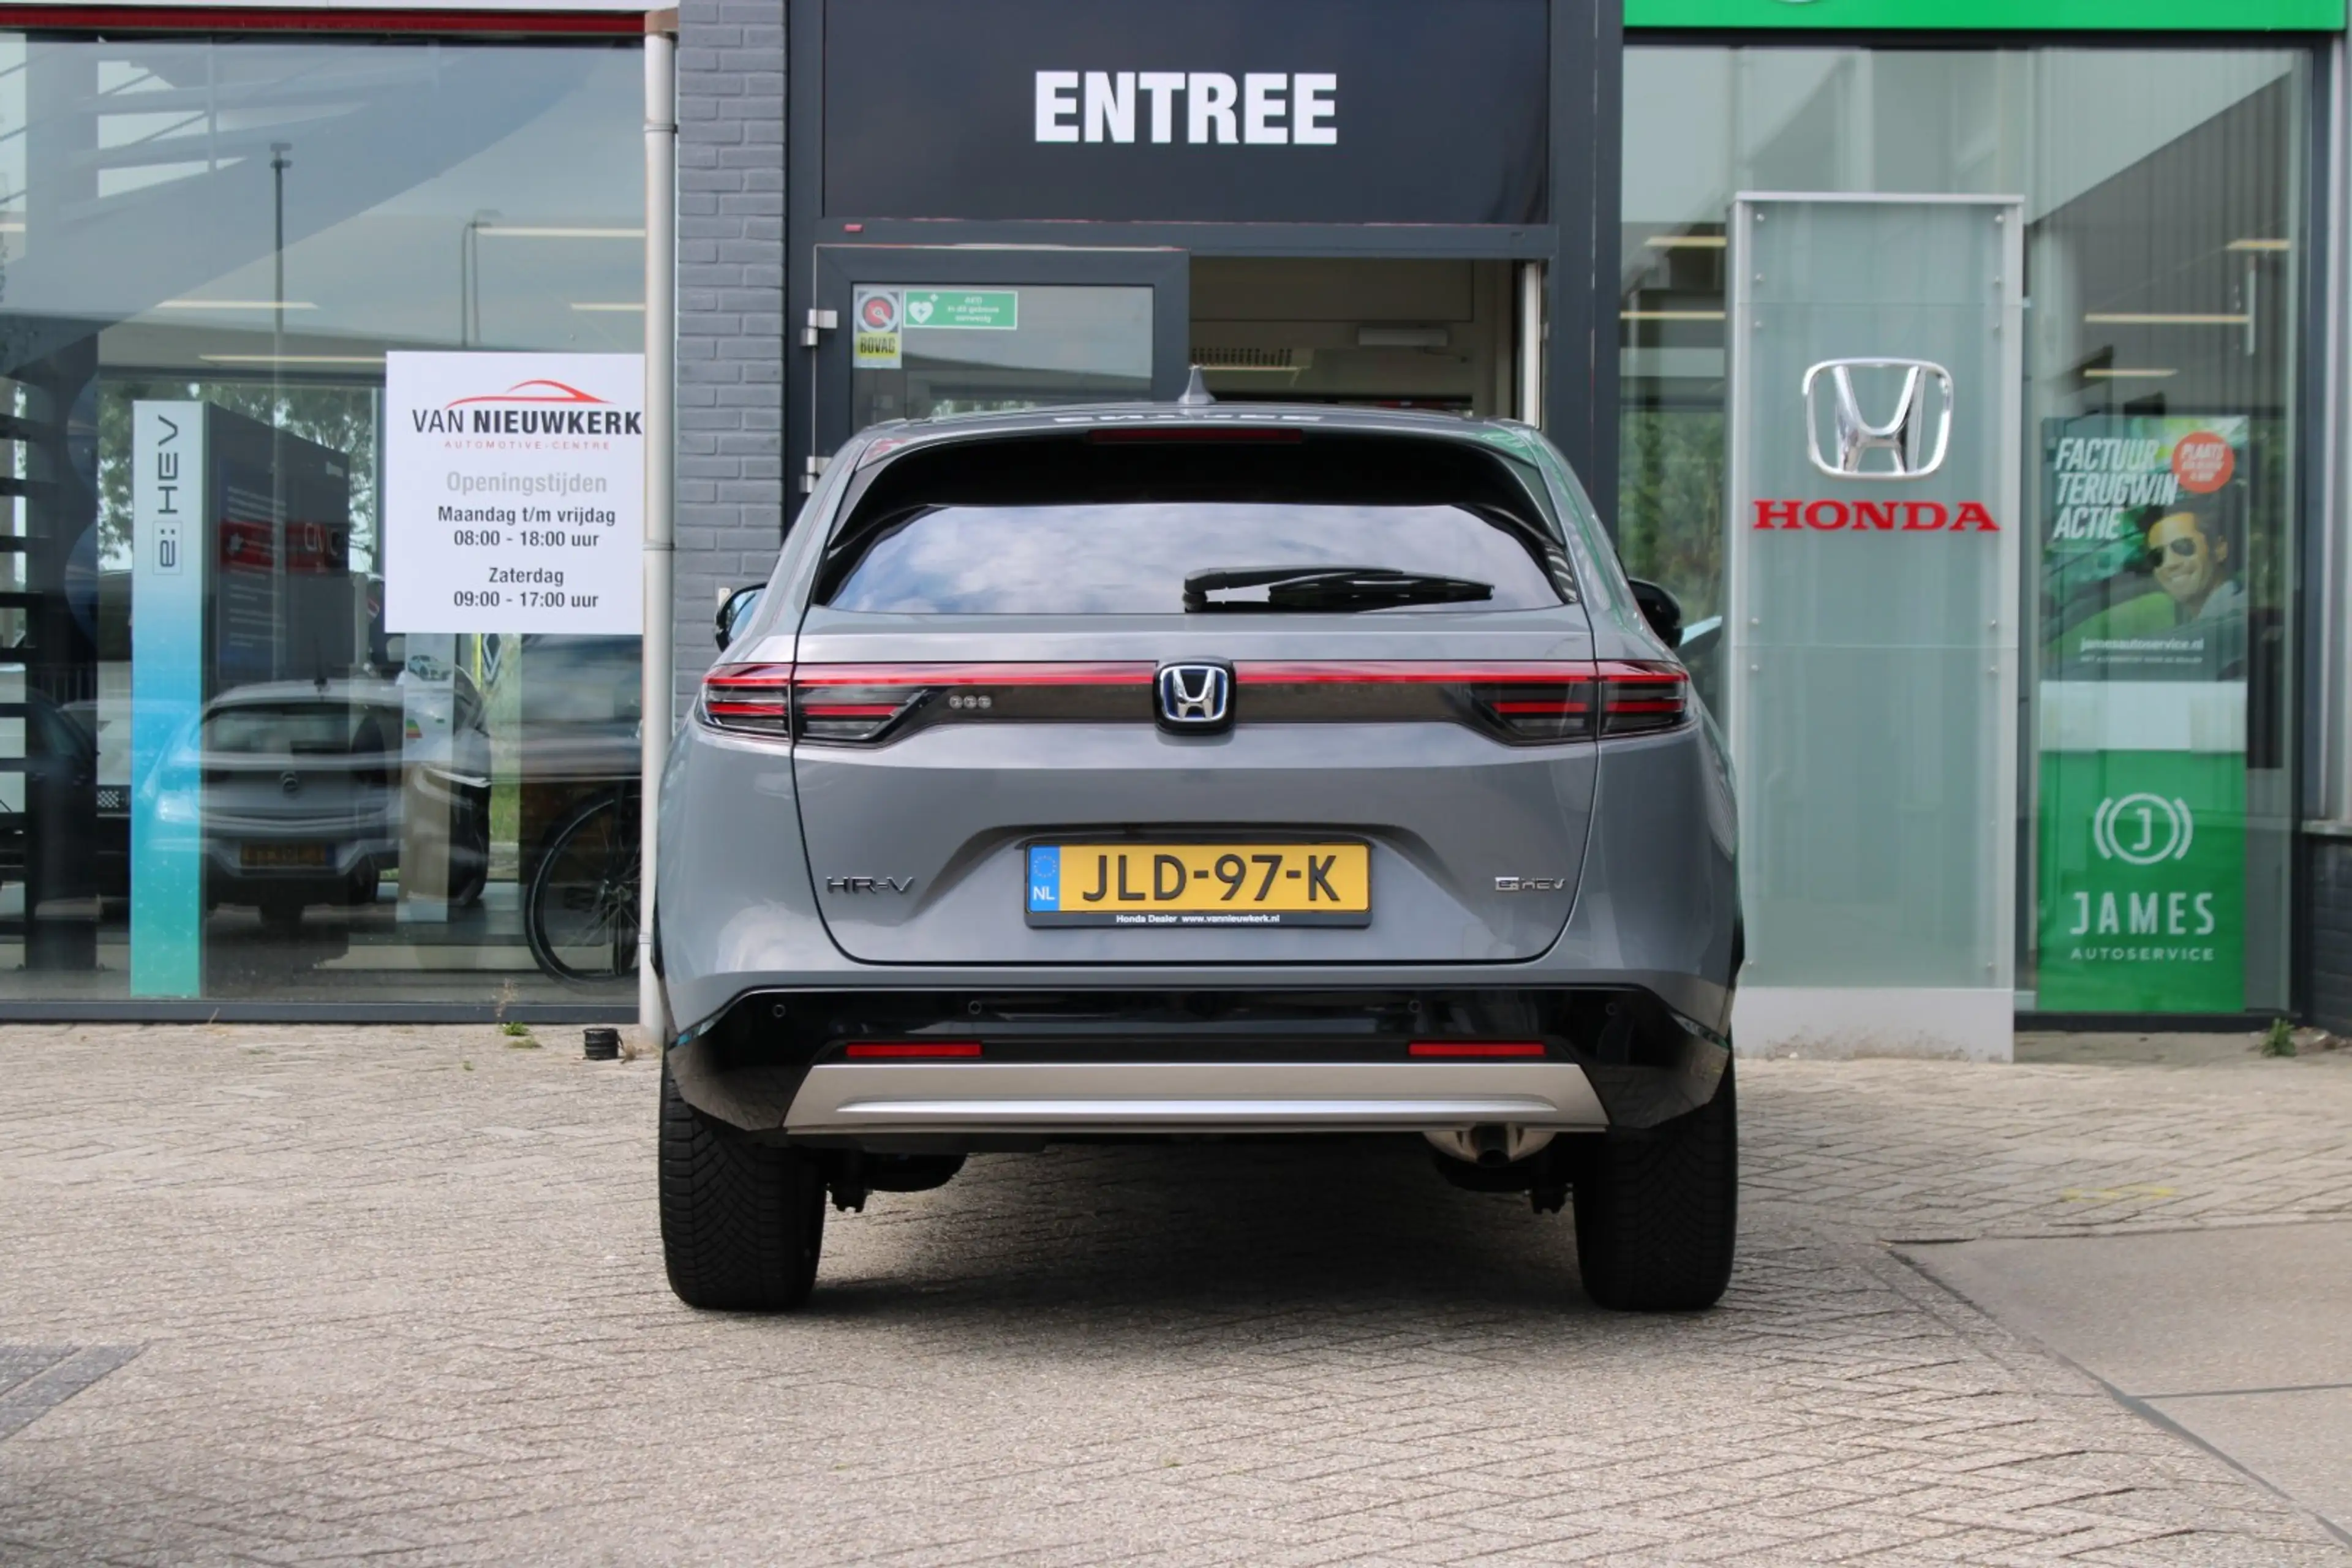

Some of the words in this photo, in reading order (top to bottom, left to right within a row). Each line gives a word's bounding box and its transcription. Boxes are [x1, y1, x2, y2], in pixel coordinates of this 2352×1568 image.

[1035, 70, 1338, 145] ENTREE
[860, 337, 895, 353] BOVAG
[412, 409, 464, 432] VAN
[473, 410, 643, 435] NIEUWKERK
[2055, 438, 2160, 471] FACTUUR
[447, 471, 608, 497] Openingstijden
[2056, 473, 2180, 506] TERUGWIN
[438, 506, 516, 526] Maandag
[522, 507, 552, 523] t/m
[557, 507, 616, 526] vrijdag
[1752, 499, 2002, 532] HONDA
[2053, 507, 2124, 540] ACTIE
[454, 530, 500, 546] 08:00
[520, 531, 565, 548] 18:00
[571, 535, 600, 547] uur
[488, 567, 565, 586] Zaterdag
[454, 591, 500, 608] 09:00
[520, 592, 565, 608] 17:00
[571, 596, 599, 608] uur
[826, 876, 914, 894] HR-V
[1033, 886, 1055, 900] NL
[1082, 854, 1341, 902] JLD-97-K
[1182, 915, 1280, 924] www.vannieuwkerk.nl
[2070, 892, 2215, 935] JAMES
[2070, 948, 2215, 961] AUTOSERVICE
